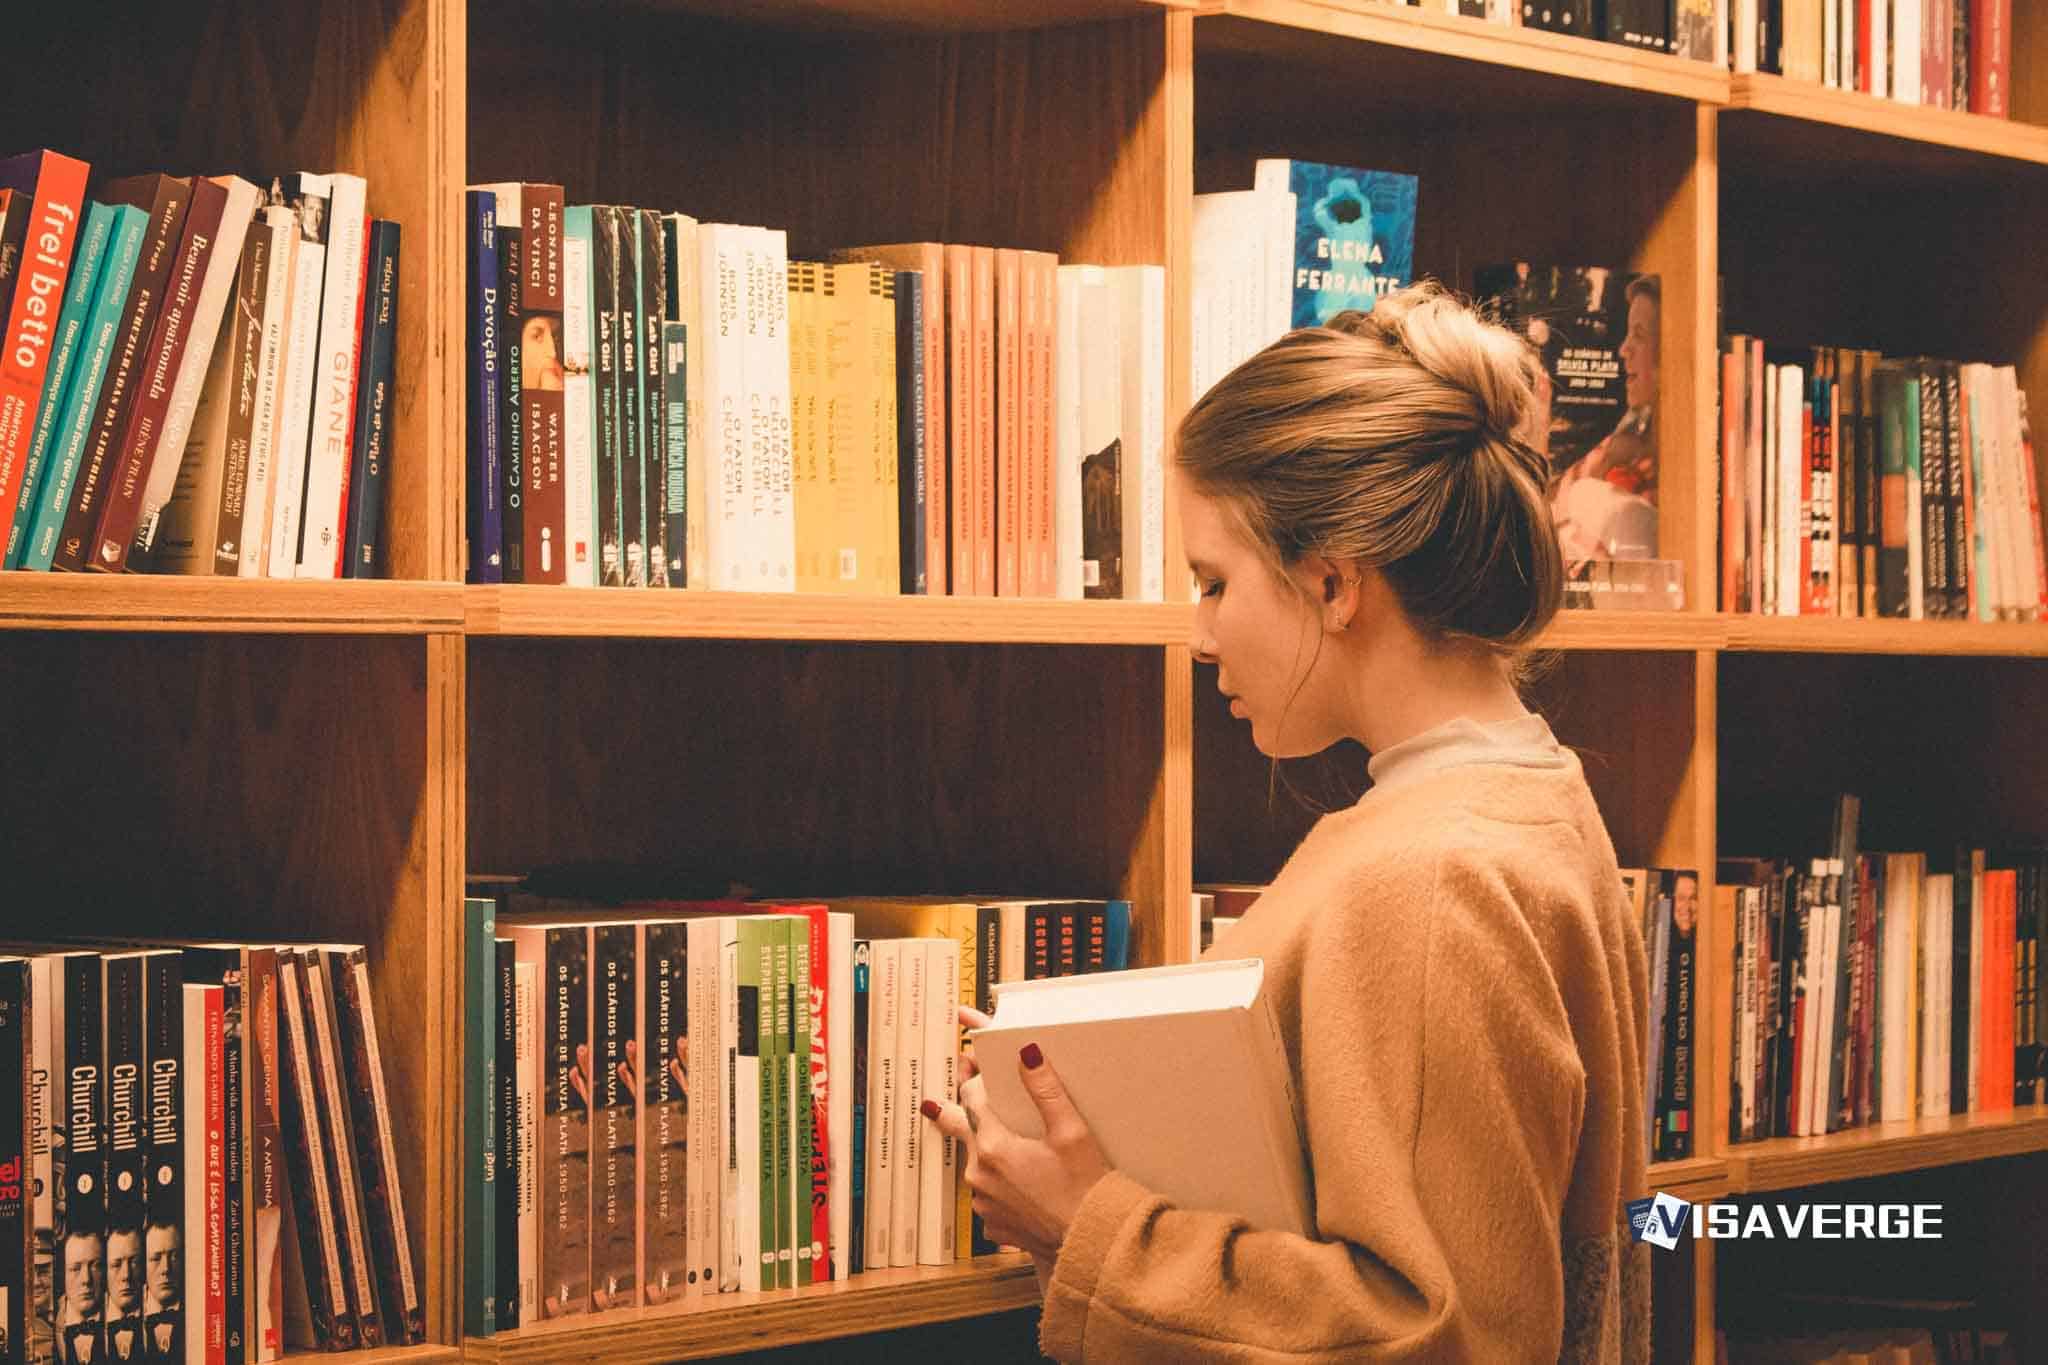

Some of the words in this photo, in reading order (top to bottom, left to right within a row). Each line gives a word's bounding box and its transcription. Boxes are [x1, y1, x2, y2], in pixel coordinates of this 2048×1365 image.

[36, 200, 75, 264] frei
[158, 199, 178, 236] Walter
[531, 207, 540, 228] DA
[531, 238, 540, 287] VINCI
[548, 200, 556, 296] LEONARDO
[1317, 237, 1384, 264] ELENA
[174, 232, 208, 308] Beauvoir
[382, 256, 395, 292] Forjaz
[1296, 268, 1400, 297] FERRANTE
[14, 271, 60, 368] betto
[483, 287, 496, 371] Devoção
[600, 311, 609, 338] Lab
[623, 311, 632, 338] Lab
[648, 316, 657, 342] Lab
[146, 307, 187, 401] apaixonada
[601, 343, 610, 371] Girl
[624, 343, 633, 371] Girl
[648, 347, 657, 375] Girl
[509, 345, 519, 405] ABERTO
[5, 398, 27, 448] Américo
[103, 407, 116, 427] DA
[324, 351, 349, 456] GIANE
[668, 402, 684, 422] UMA
[31, 429, 47, 457] forte
[509, 411, 519, 486] CAMINHO
[532, 402, 540, 489] ISAACSON
[548, 412, 556, 482] WALTER
[668, 426, 685, 468] INFÂNCIA
[78, 430, 110, 513] LIBERDADE
[509, 494, 519, 506] O
[559, 965, 567, 981] OS
[608, 961, 616, 976] OS
[660, 959, 668, 974] OS
[760, 945, 771, 1000] STEPHEN
[775, 945, 787, 1000] STEPHEN
[796, 944, 809, 999] STEPHEN
[1679, 952, 1689, 964] O
[608, 982, 618, 1036] DIÁRIOS
[660, 979, 670, 1032] DIÁRIOS
[1678, 969, 1688, 1011] LIVRO
[262, 974, 272, 1050] SAMANTHA
[559, 986, 568, 1040] DIÁRIOS
[760, 1006, 771, 1036] KING
[1677, 1016, 1687, 1039] DO
[559, 1046, 567, 1061] DE
[608, 1041, 616, 1056] DE
[659, 1037, 668, 1053] DE
[229, 1086, 238, 1107] vida
[504, 1076, 511, 1085] A
[559, 1067, 567, 1111] SYLVIA
[608, 1061, 616, 1105] SYLVIA
[659, 1057, 668, 1101] SYLVIA
[30, 1069, 51, 1155] Churchill
[70, 1064, 97, 1151] Churchill
[111, 1063, 137, 1150] Churchill
[151, 1058, 177, 1144] Churchill
[778, 1106, 788, 1117] A
[210, 1130, 218, 1140] O
[263, 1136, 271, 1146] A
[559, 1115, 567, 1154] PLATH
[608, 1110, 616, 1148] PLATH
[659, 1106, 667, 1144] PLATH
[210, 1144, 218, 1167] QUE
[210, 1170, 220, 1178] É
[263, 1151, 272, 1208] MENINA
[559, 1162, 567, 1230] 1950-1962
[608, 1157, 616, 1223] 1950-1962
